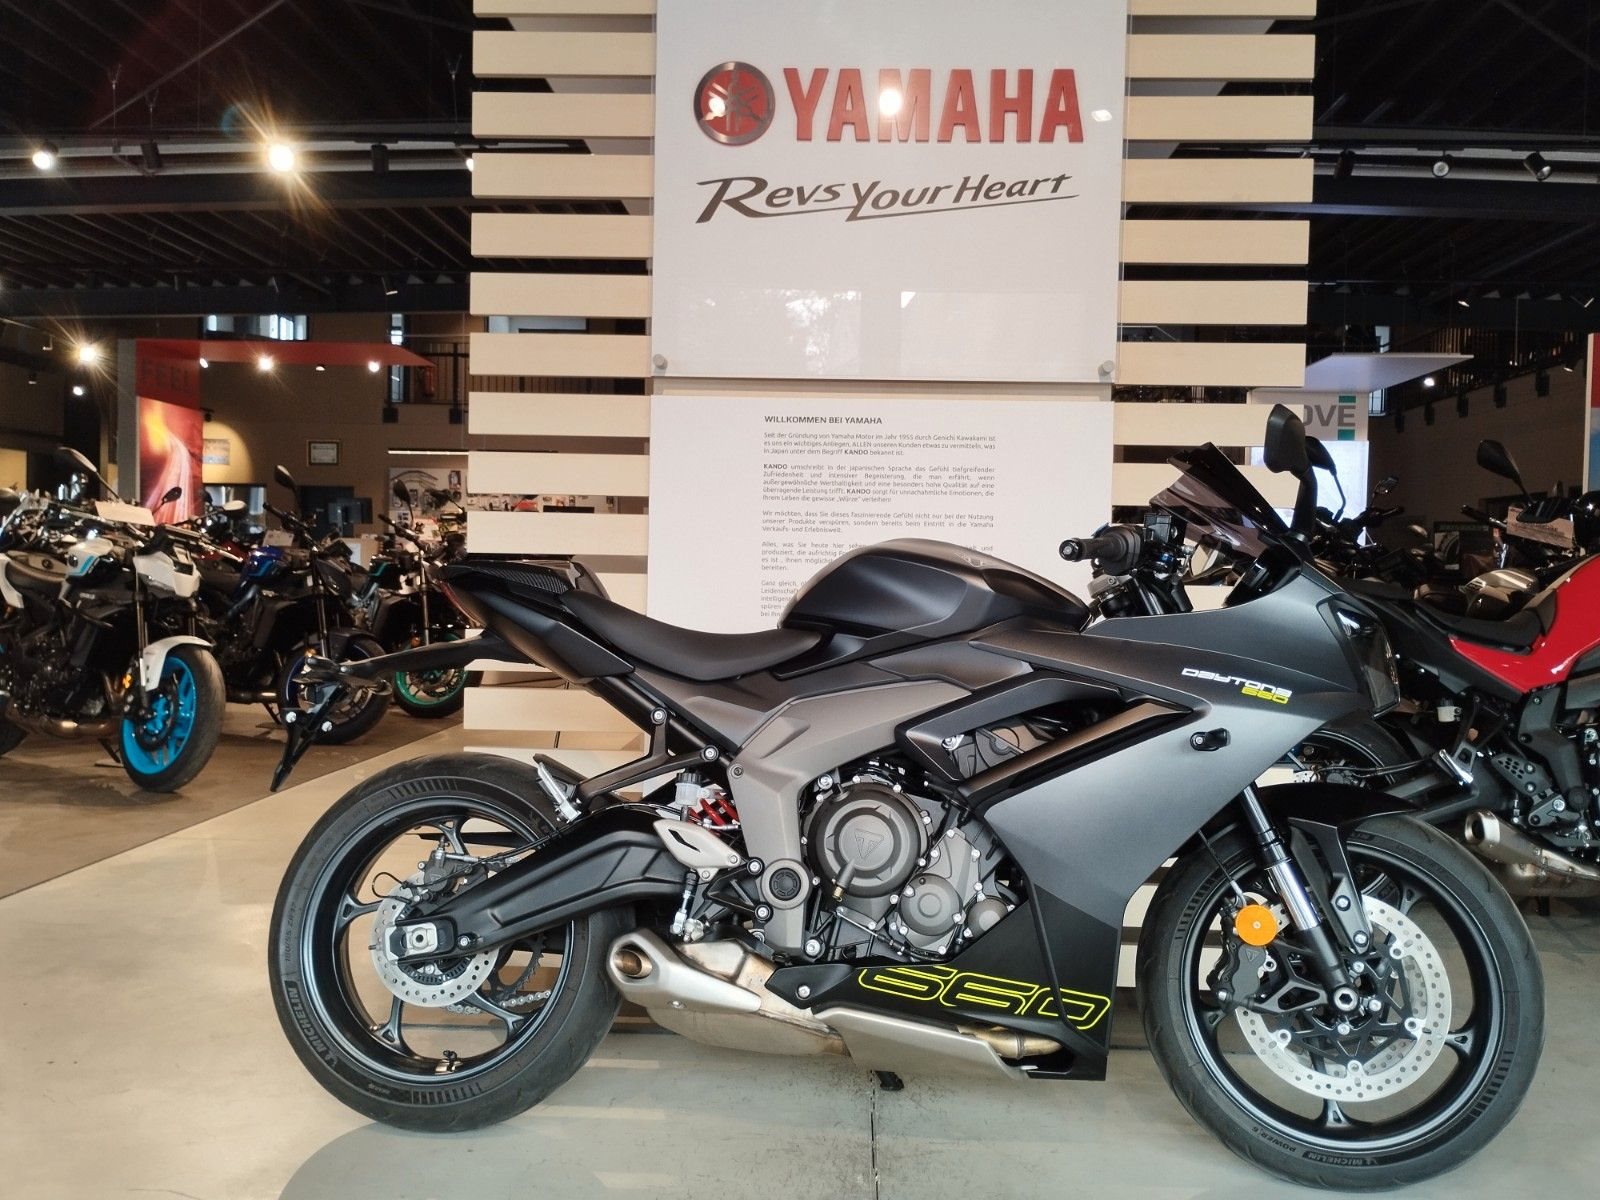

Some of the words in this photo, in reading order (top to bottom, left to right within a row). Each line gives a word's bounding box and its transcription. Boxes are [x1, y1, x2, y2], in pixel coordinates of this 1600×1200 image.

[783, 68, 1084, 143] YAMAHA
[696, 175, 846, 223] Revs
[845, 180, 954, 222] Your
[951, 172, 1074, 205] Heart
[288, 987, 328, 1053] MICHELIN
[858, 964, 1111, 1030] 660
[1308, 1152, 1362, 1166] MICHELIN
